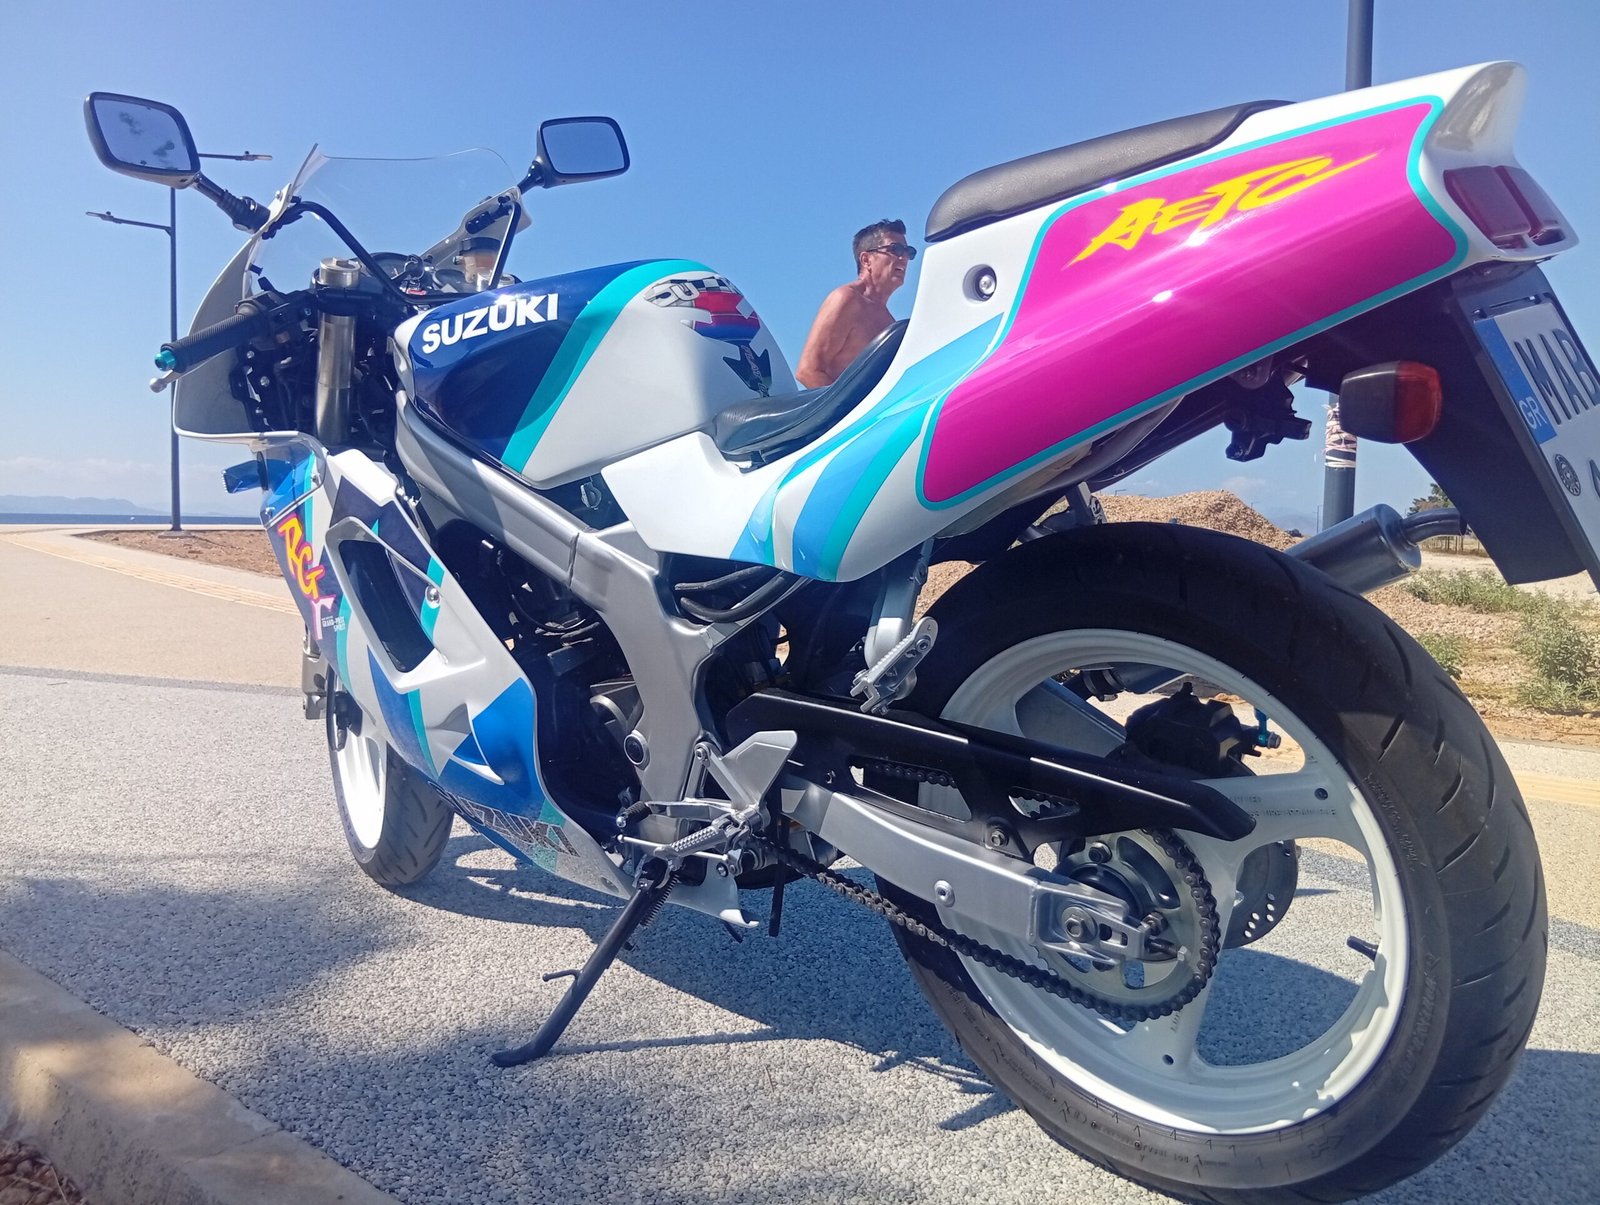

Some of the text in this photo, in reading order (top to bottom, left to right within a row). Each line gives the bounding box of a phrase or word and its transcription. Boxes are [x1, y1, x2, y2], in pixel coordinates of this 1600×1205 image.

[1062, 150, 1380, 269] AETC
[421, 293, 560, 355] SUZUKI
[1513, 328, 1600, 426] MAB
[1518, 396, 1548, 430] GR
